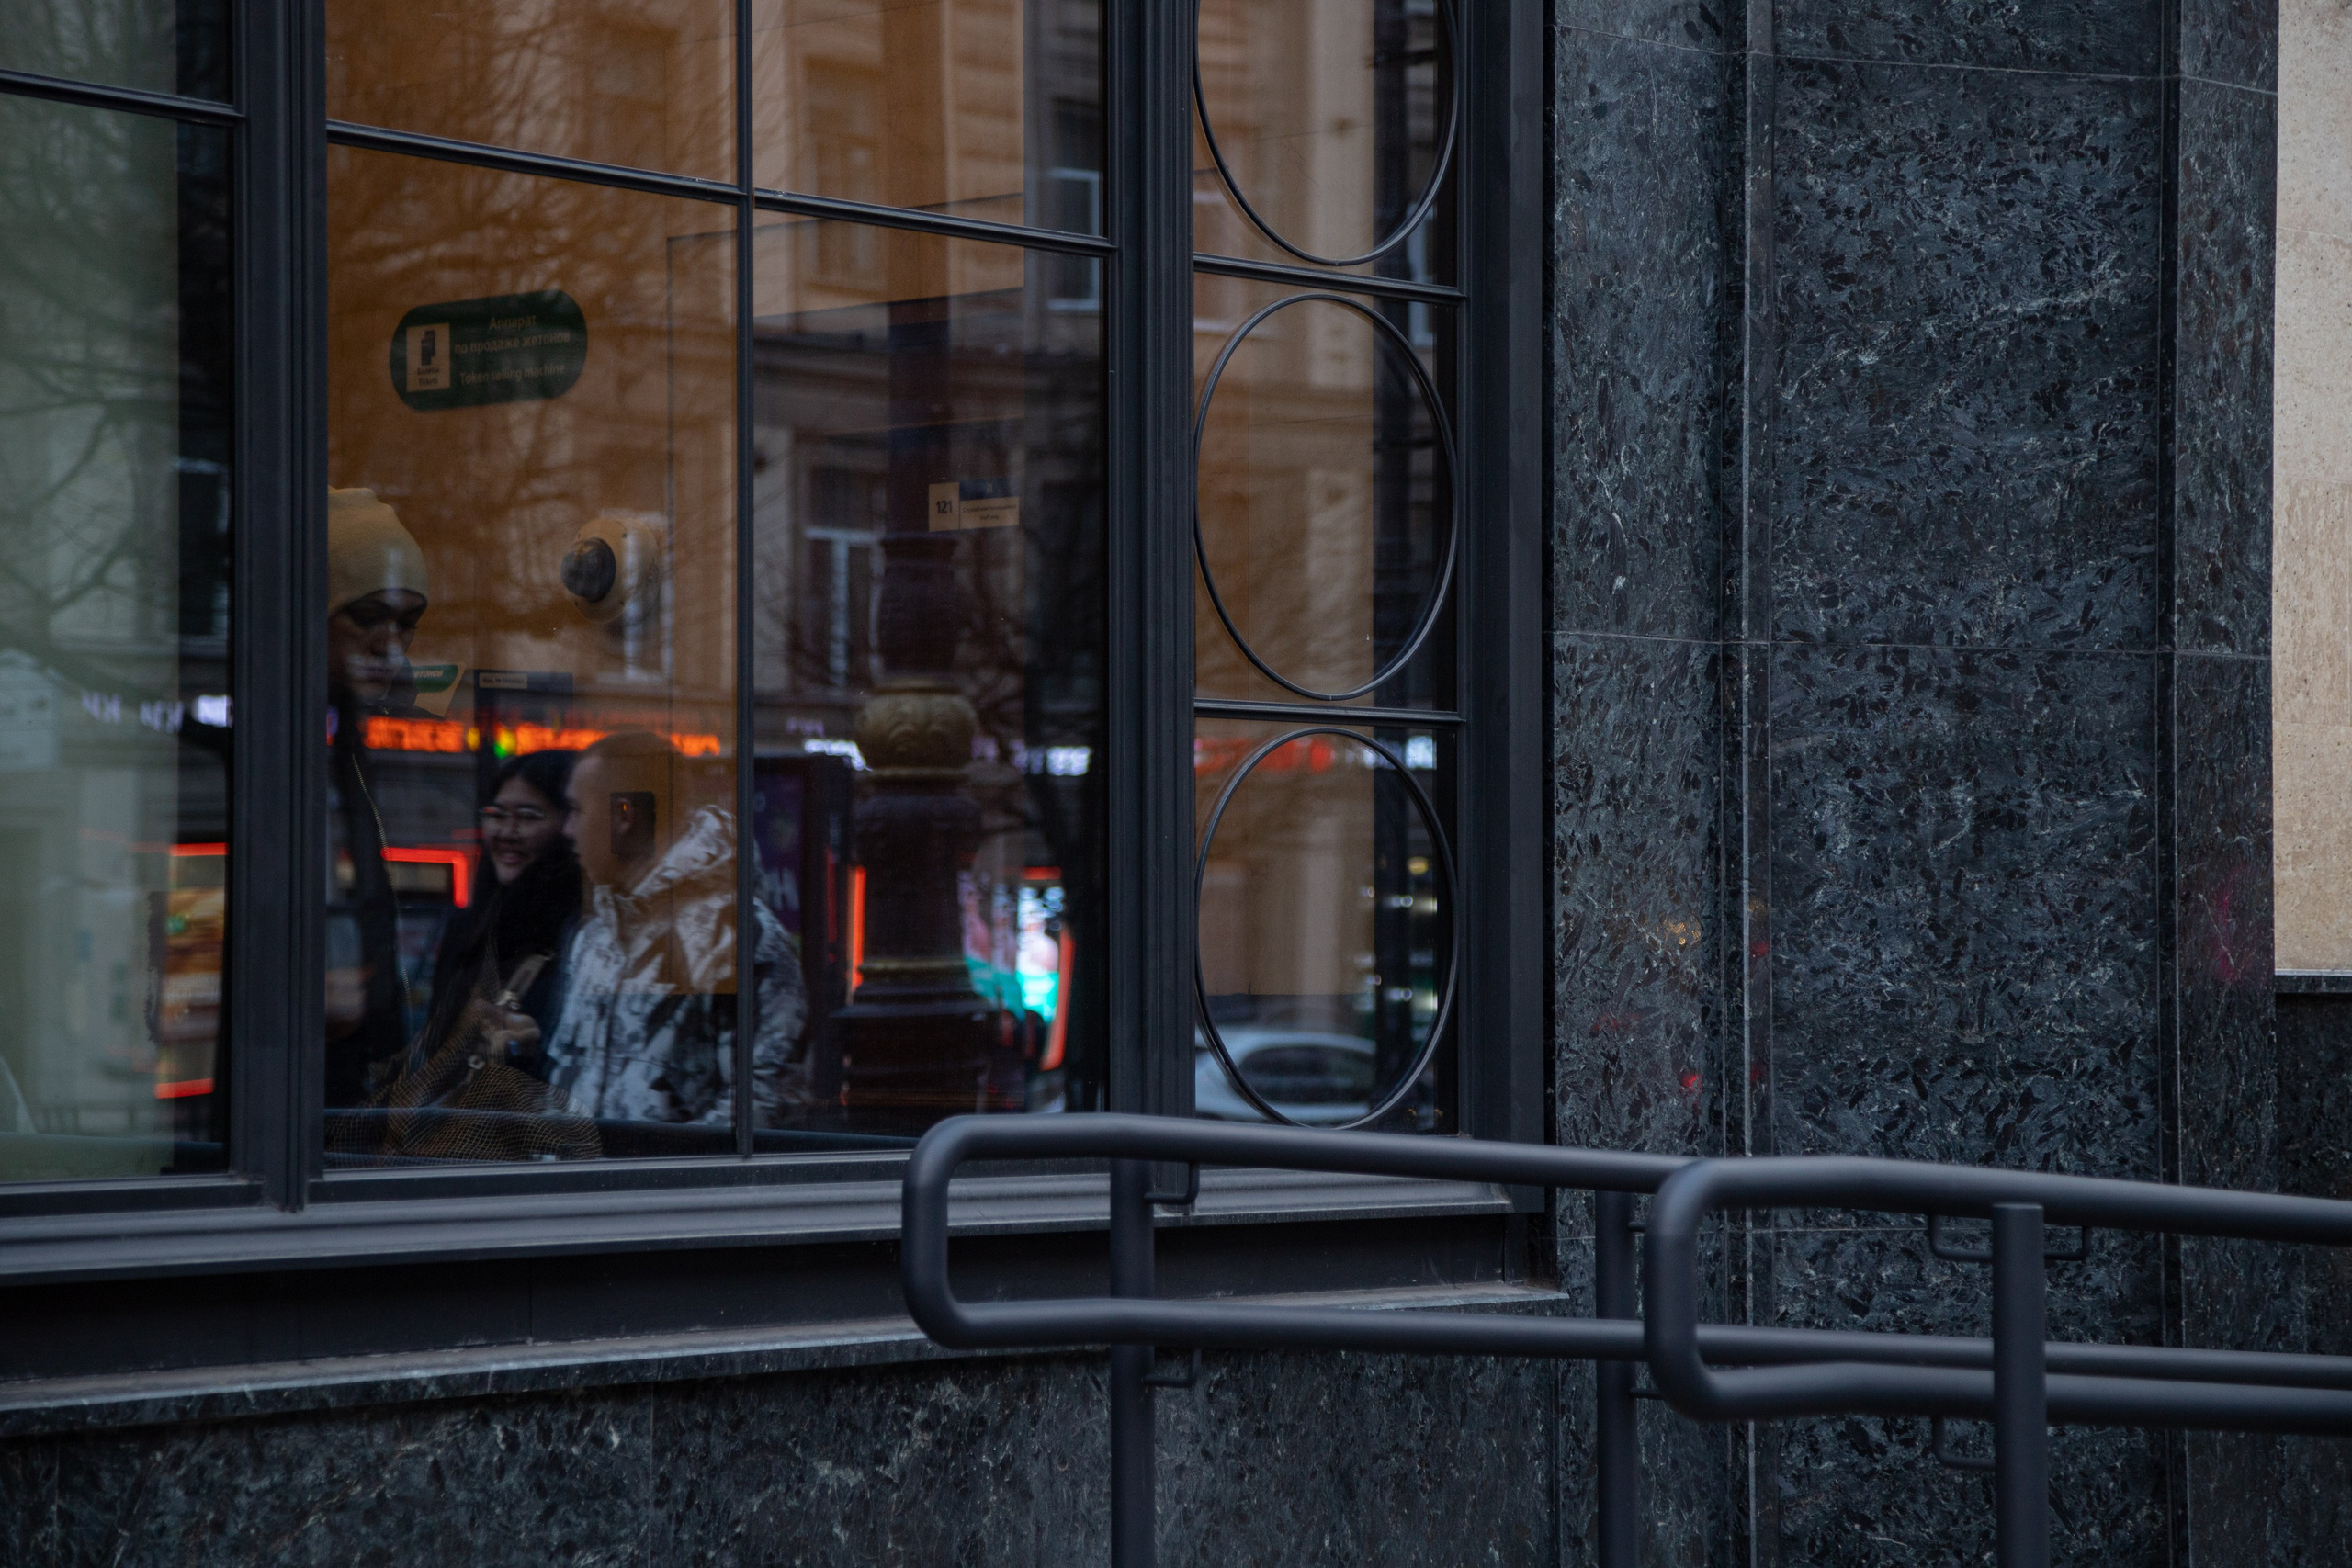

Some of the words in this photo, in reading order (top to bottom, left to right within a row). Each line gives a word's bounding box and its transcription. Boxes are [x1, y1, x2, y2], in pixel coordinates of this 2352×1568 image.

[489, 315, 537, 330] Аппарат
[454, 343, 468, 355] по
[470, 338, 520, 355] продаже
[523, 332, 571, 347] жетонов
[459, 372, 490, 385] Token
[491, 367, 522, 382] selling
[524, 364, 566, 378] machine
[936, 500, 953, 513] 121
